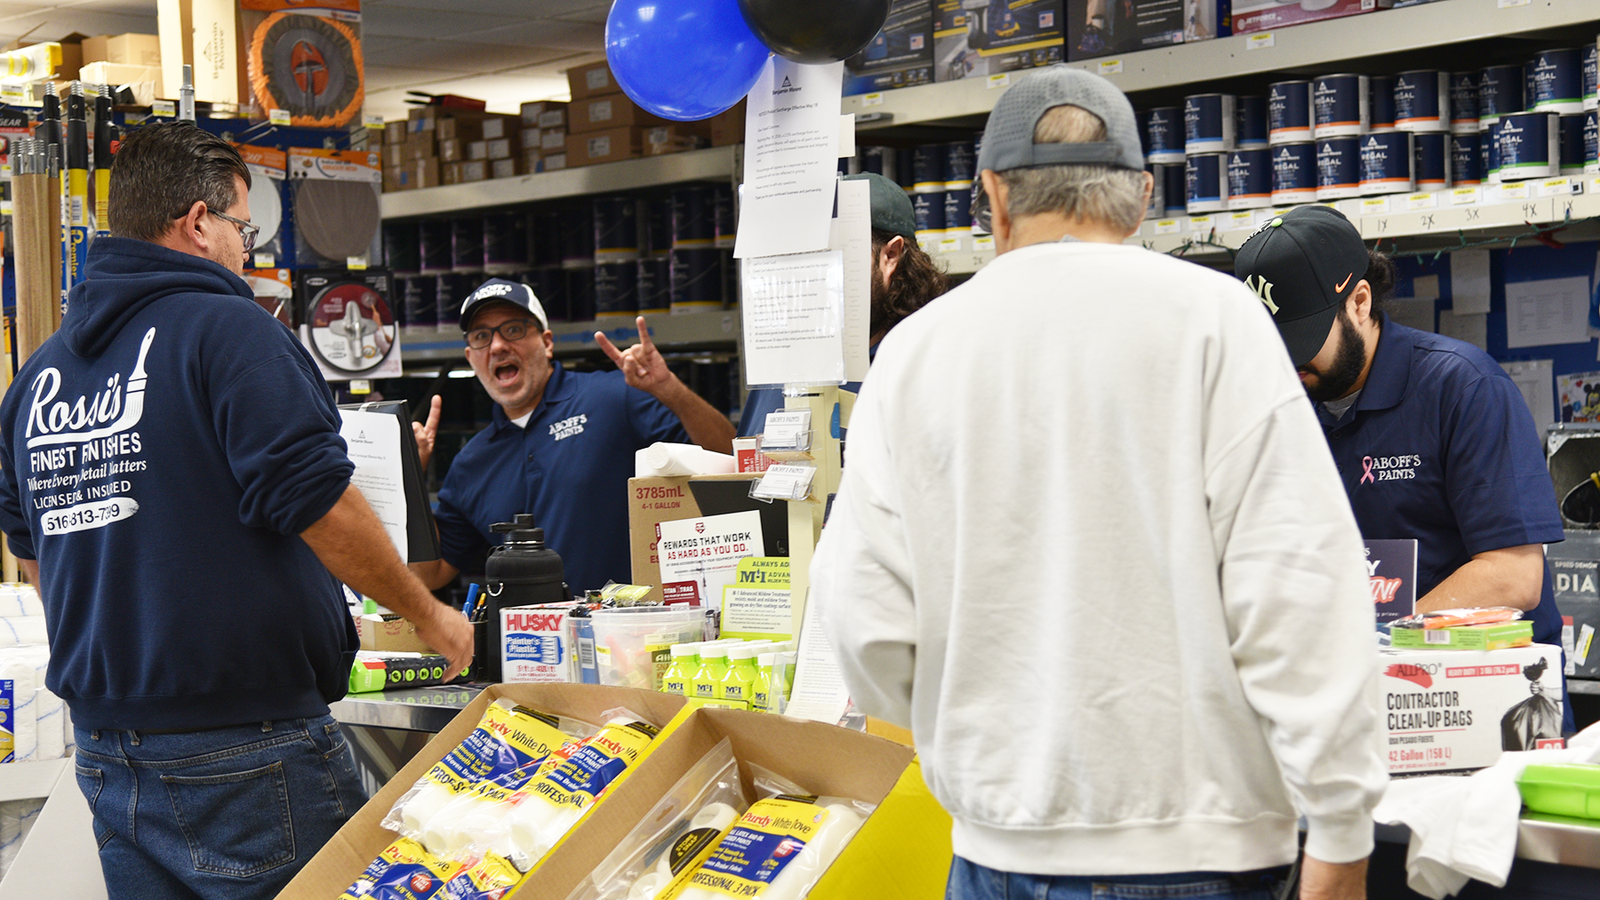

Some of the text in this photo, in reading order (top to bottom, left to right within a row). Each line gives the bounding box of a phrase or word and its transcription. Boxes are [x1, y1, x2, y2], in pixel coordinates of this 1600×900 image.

[1377, 218, 1388, 233] 1X
[1421, 213, 1436, 230] 2X
[1464, 208, 1480, 221] 3X
[1522, 203, 1538, 219] 4X
[25, 367, 122, 439] Rossi's
[548, 413, 588, 436] ABOFF'S
[554, 424, 585, 442] PAINTS
[30, 446, 77, 473] FINEST
[1372, 454, 1422, 470] ABOFF'S
[1377, 467, 1416, 481] PAINTS
[636, 485, 685, 500] 3785mL
[654, 501, 681, 510] GALLON
[663, 531, 752, 551] REWARDS THAT WORK
[667, 551, 677, 561] AS
[677, 548, 699, 560] HARD
[700, 547, 712, 557] AS
[713, 544, 731, 556] YOU
[752, 560, 779, 568] ALWAYS
[1554, 560, 1598, 569] SPEED DEMON
[506, 613, 564, 632] HUSKY
[506, 636, 541, 647] Painter's
[509, 644, 538, 654] Plastic
[1387, 690, 1460, 711] CONTRACTOR
[1387, 709, 1473, 731] CLEAN-UP BAGS
[511, 728, 539, 750] White
[445, 754, 462, 771] Woven
[1388, 750, 1398, 762] 42
[1400, 749, 1424, 761] Gallon
[1425, 748, 1444, 761] (158
[478, 784, 485, 794] 4
[742, 812, 792, 830] Purdy White
[675, 833, 694, 852] STORE
[734, 883, 743, 893] 3
